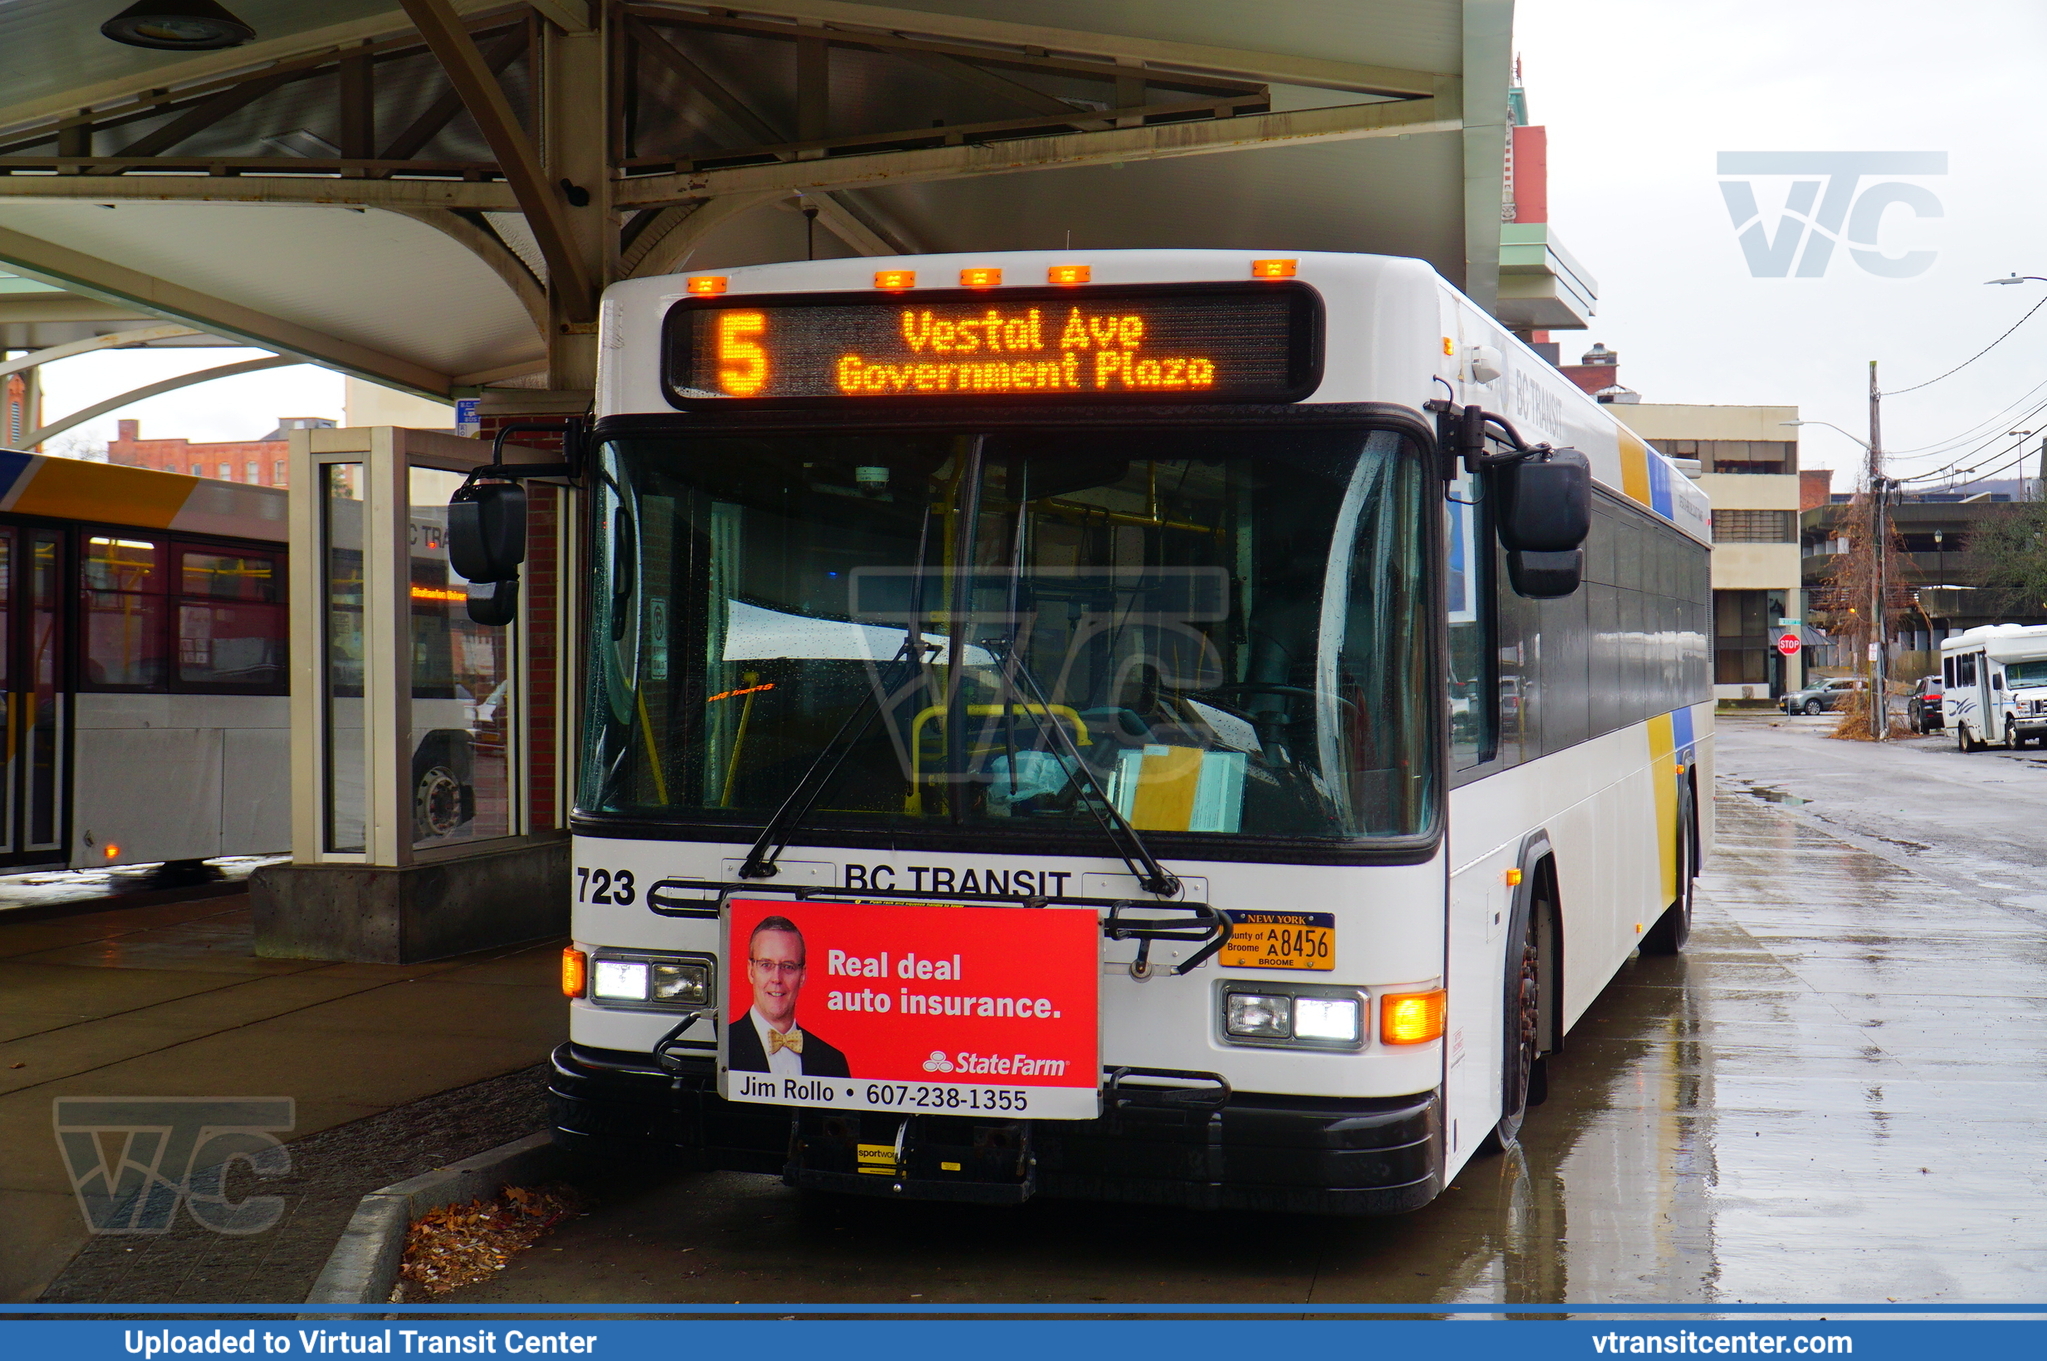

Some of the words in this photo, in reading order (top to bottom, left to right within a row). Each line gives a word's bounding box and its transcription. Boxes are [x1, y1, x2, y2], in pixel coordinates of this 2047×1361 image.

[901, 308, 1044, 352] Vestal
[1061, 306, 1143, 349] Ave
[718, 310, 768, 396] 5
[838, 353, 1080, 394] Government
[1095, 350, 1215, 390] Plaza
[1530, 375, 1563, 441] TRANSIT
[1780, 639, 1800, 649] STOP
[576, 867, 636, 906] 723
[846, 864, 896, 893] BC
[908, 866, 1071, 898] TRANSIT
[1247, 914, 1275, 923] NEW
[1277, 915, 1307, 925] YORK
[1227, 942, 1260, 952] Broome
[1230, 932, 1253, 942] unty
[1254, 932, 1264, 941] of
[1281, 929, 1328, 958] 8456
[827, 949, 888, 978] Real
[897, 953, 961, 981] deal
[1258, 958, 1294, 967] BROOME
[827, 988, 892, 1014] auto
[900, 988, 1062, 1019] insurance.
[740, 1076, 780, 1100] Jim
[784, 1078, 835, 1102] Rollo
[866, 1085, 1028, 1111] 607-238-1355
